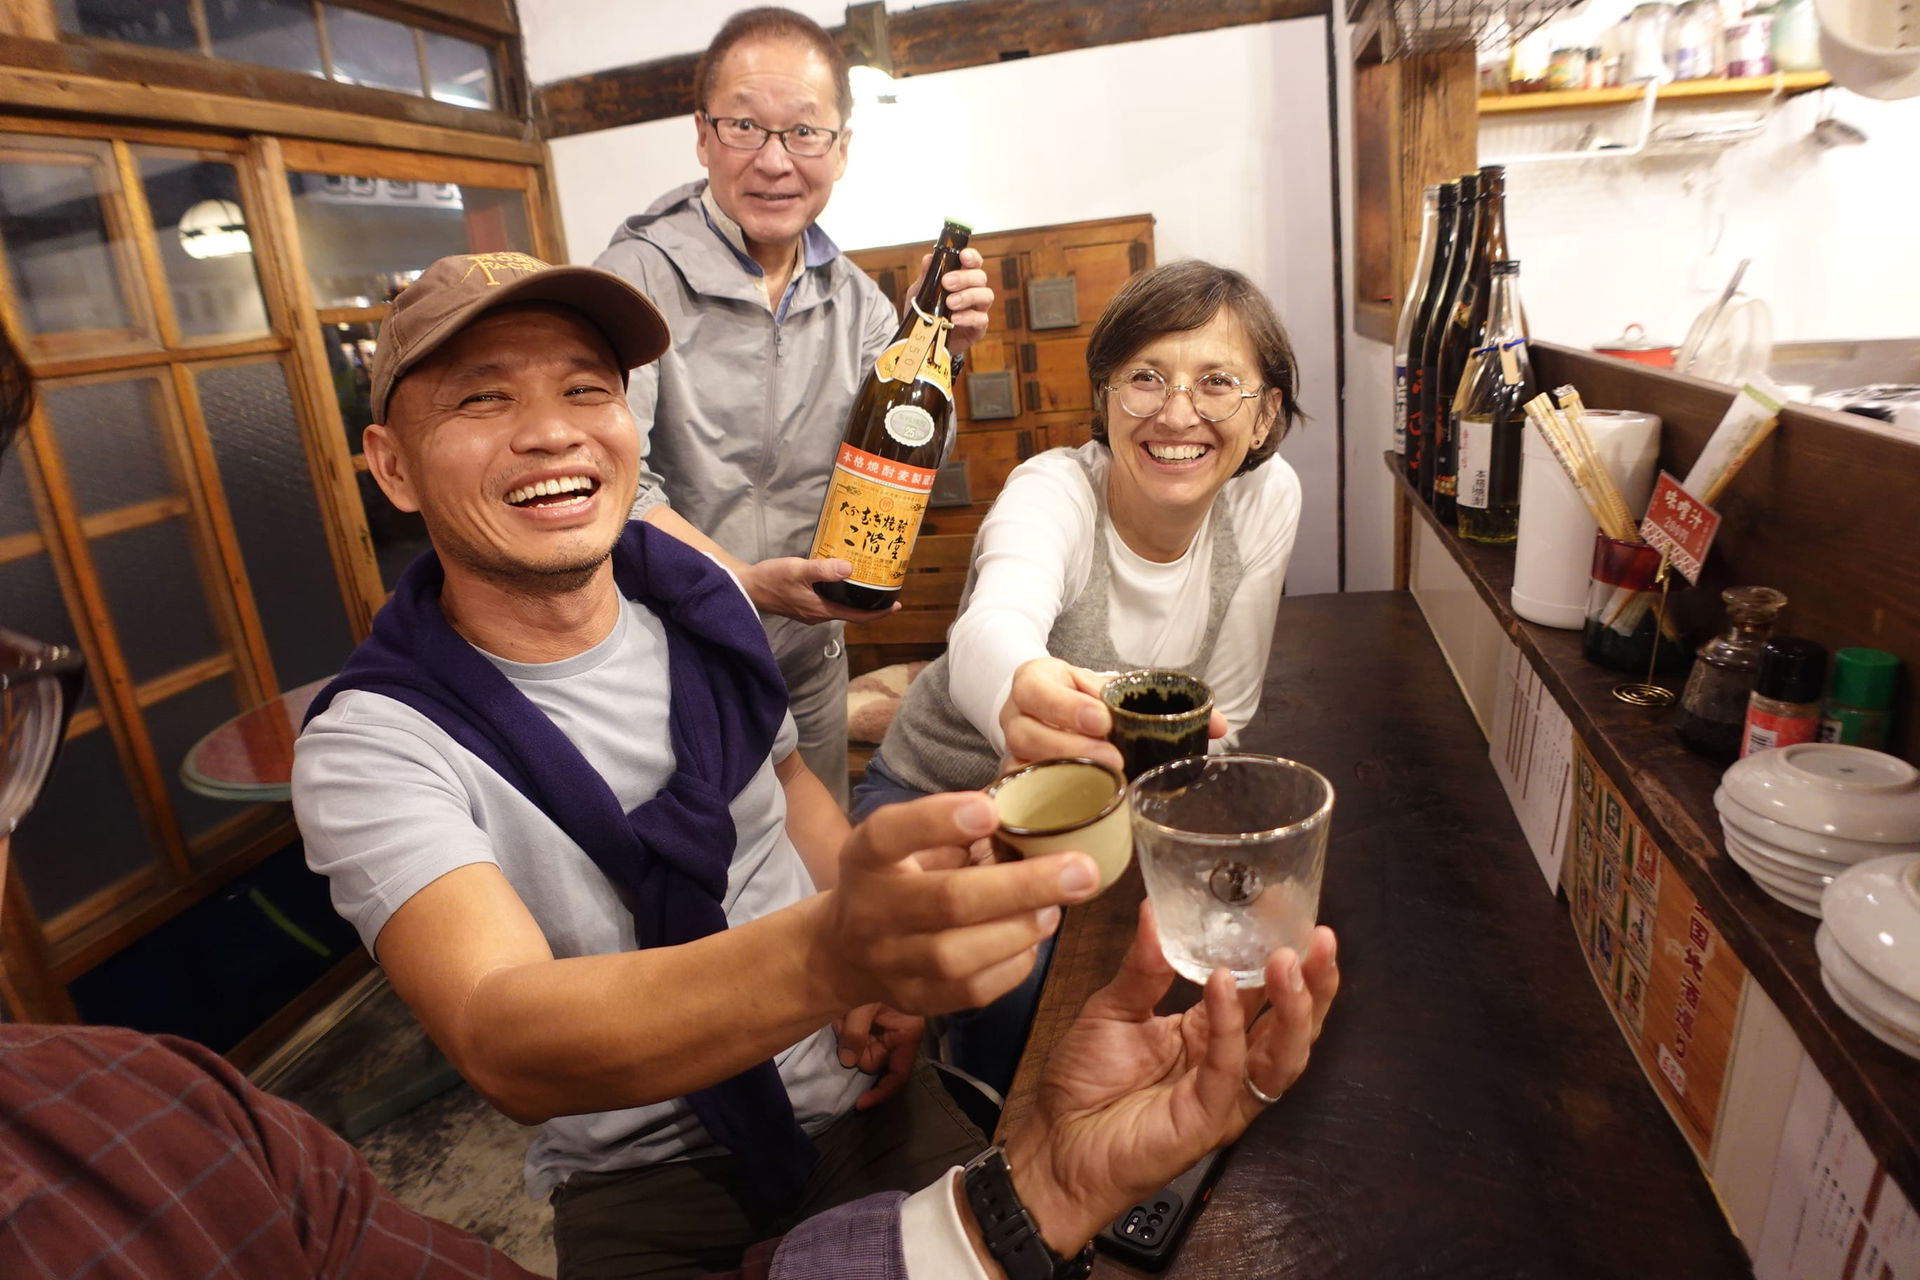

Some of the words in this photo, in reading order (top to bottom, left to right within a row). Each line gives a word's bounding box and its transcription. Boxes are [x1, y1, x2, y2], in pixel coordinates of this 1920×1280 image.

[905, 332, 925, 367] 550
[903, 426, 916, 438] 25
[843, 522, 907, 560] 二階堂
